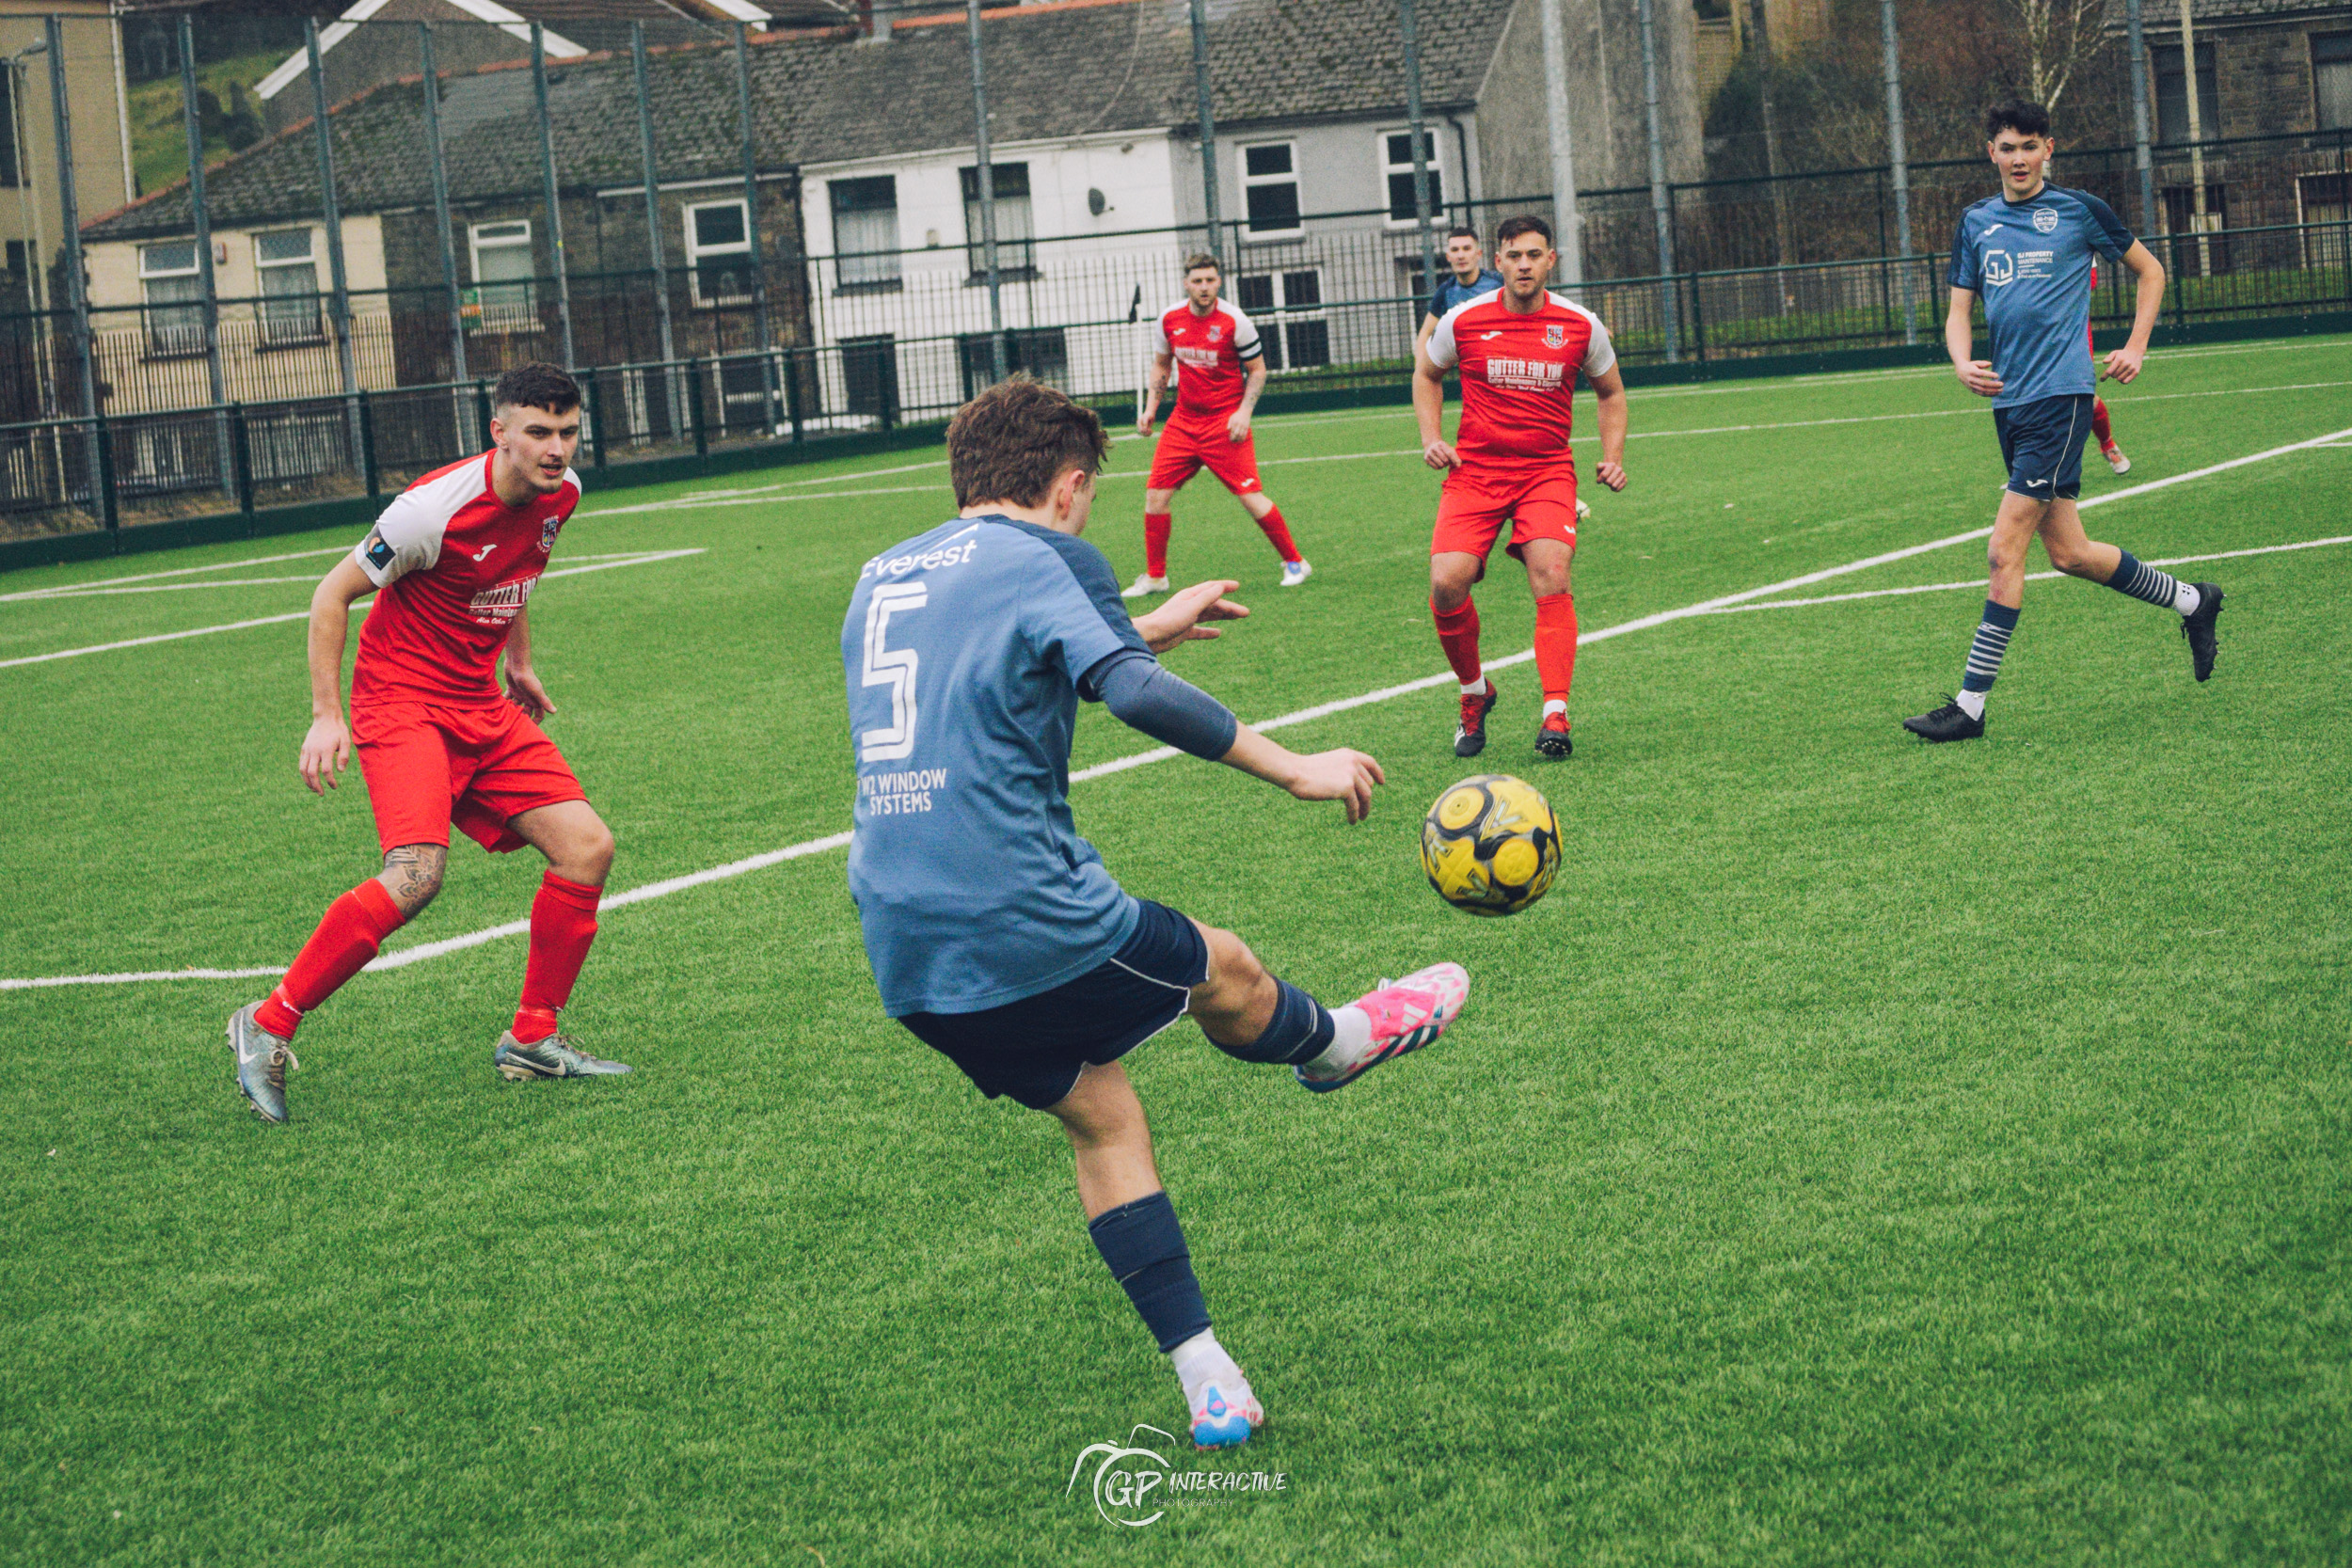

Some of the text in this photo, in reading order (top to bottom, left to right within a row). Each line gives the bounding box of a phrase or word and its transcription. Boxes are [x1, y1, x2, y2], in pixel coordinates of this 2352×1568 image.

[1487, 359, 1562, 378] GUTTER FOR YOU
[859, 539, 977, 579] Everest
[470, 584, 519, 605] GUTTER
[862, 581, 928, 762] 5
[878, 768, 946, 794] WINDOW
[869, 791, 932, 816] SYSTEMS
